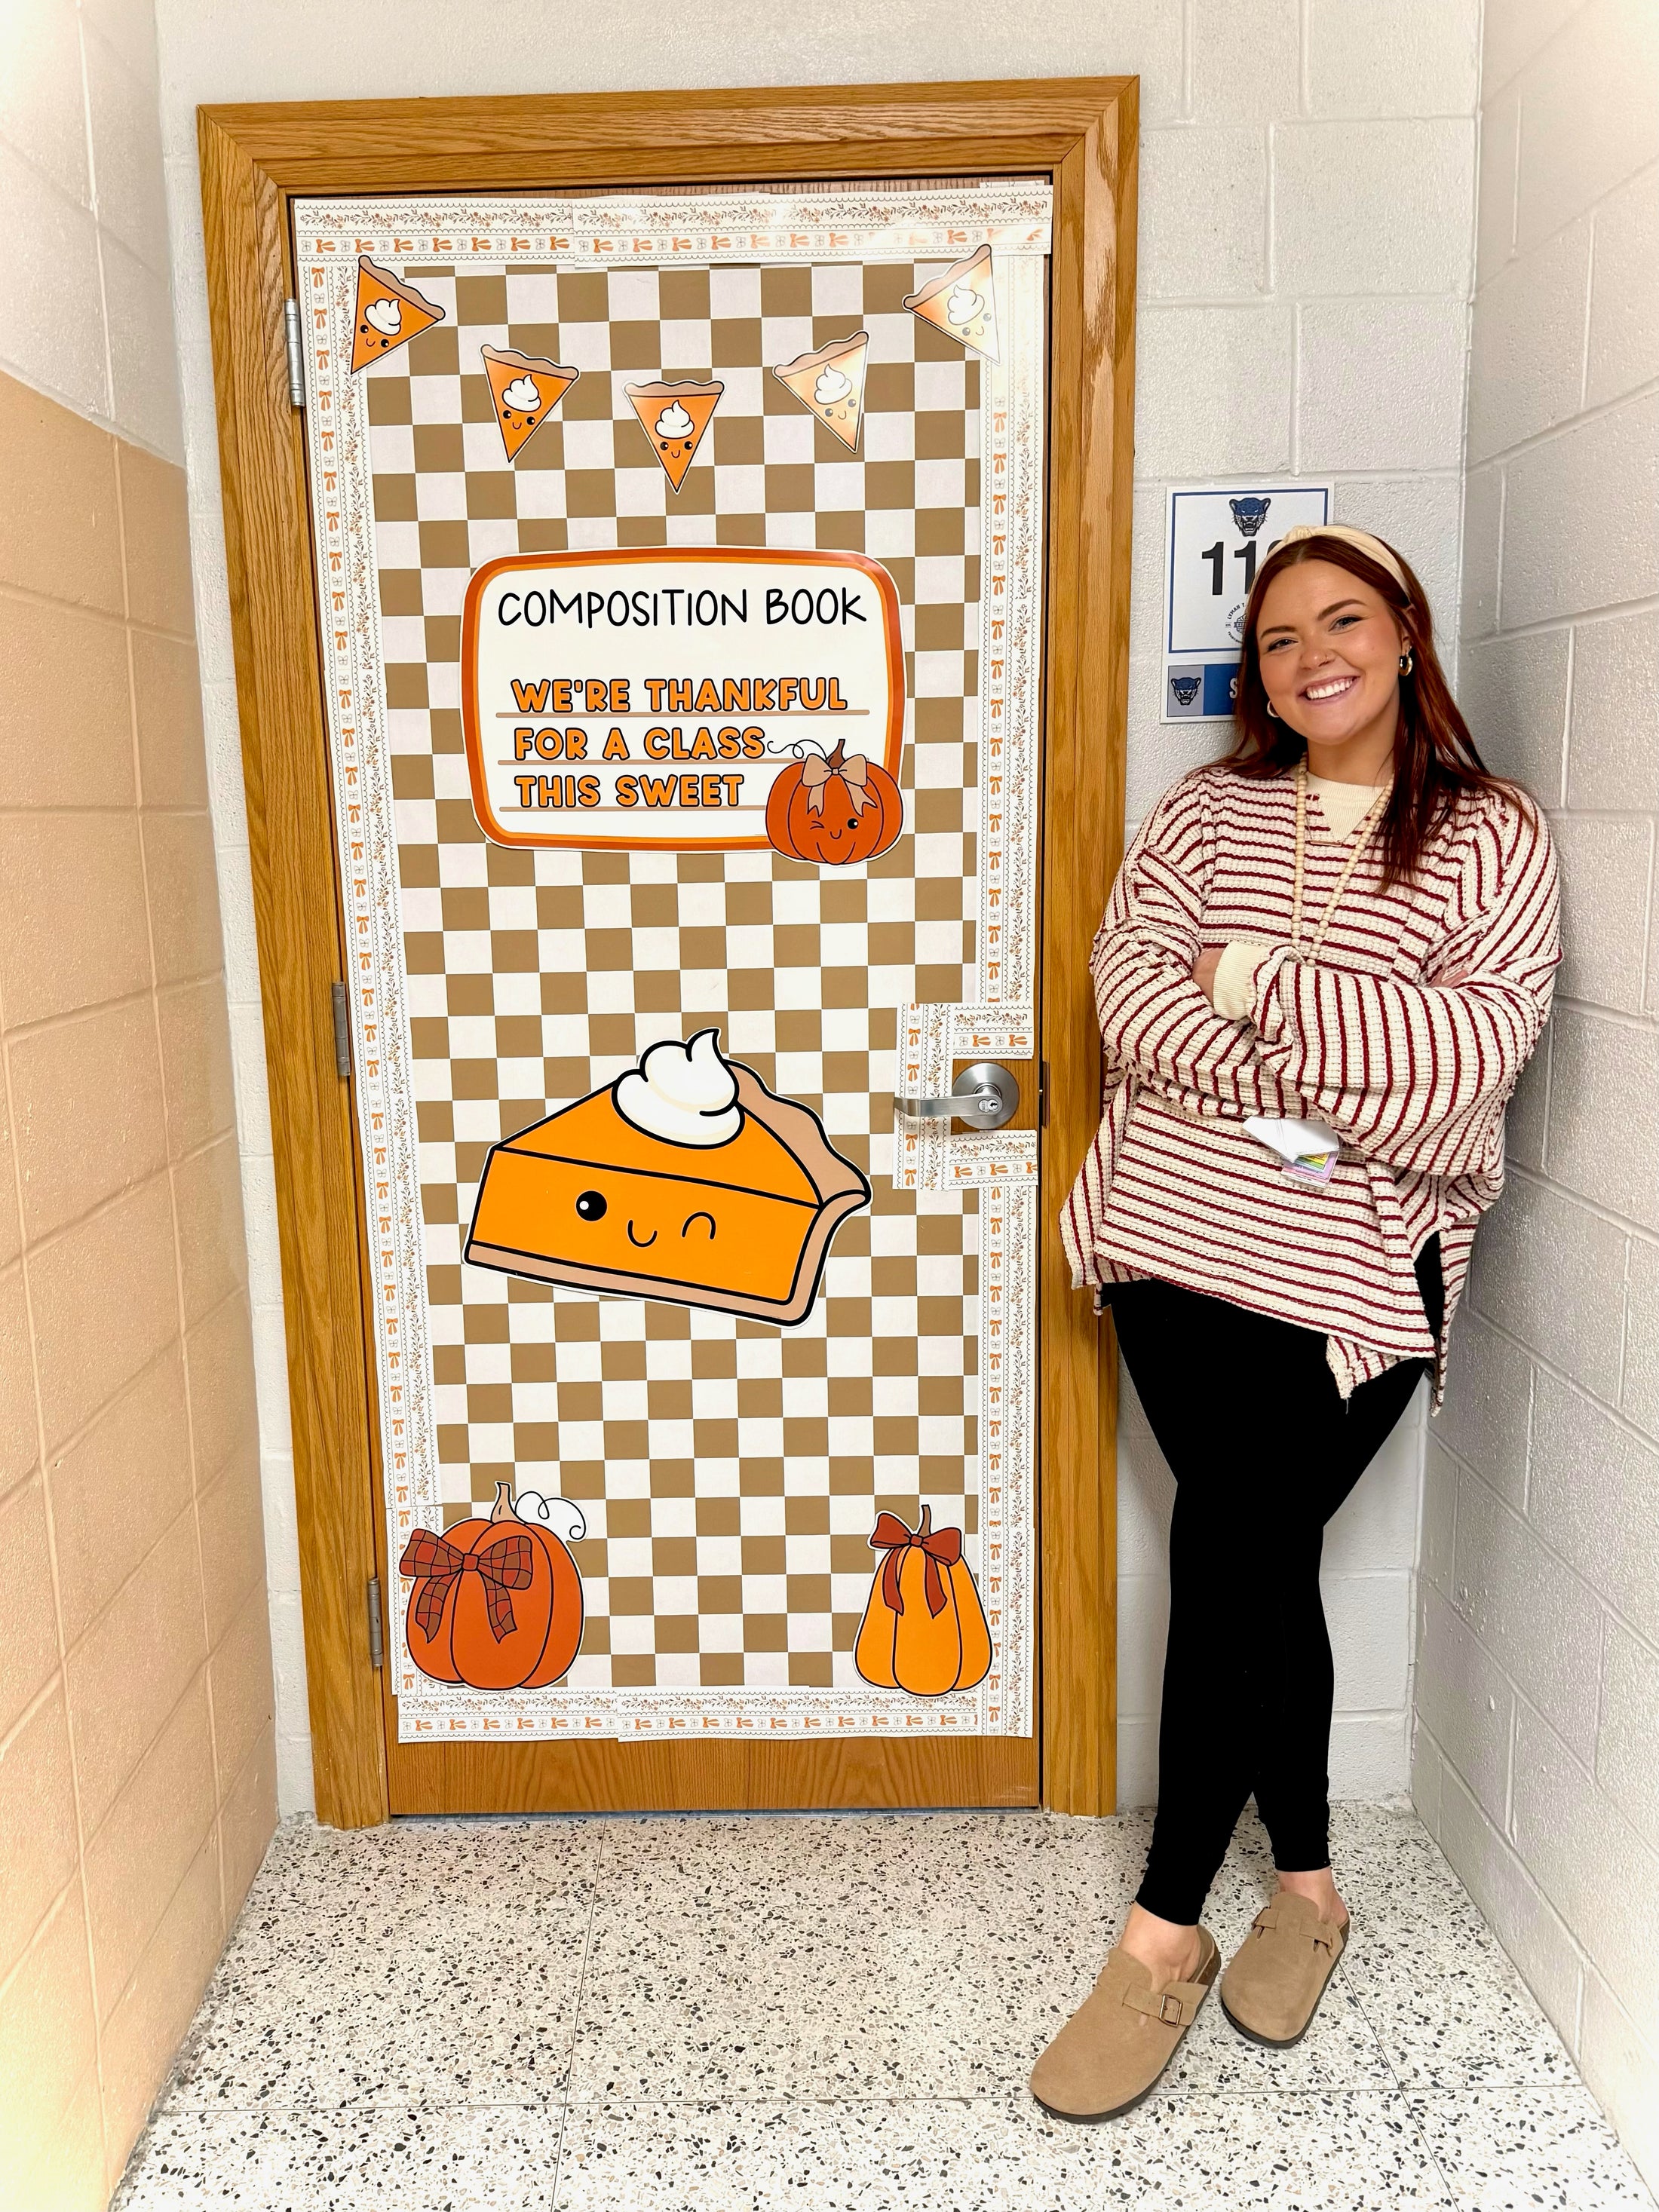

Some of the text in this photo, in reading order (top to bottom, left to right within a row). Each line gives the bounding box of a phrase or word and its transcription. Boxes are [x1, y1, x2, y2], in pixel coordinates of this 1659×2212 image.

[1202, 540, 1283, 595] 11
[498, 587, 867, 628] COMPOSITION BOOK
[511, 677, 848, 713] WE'RE THANKFUL
[514, 726, 765, 761] FOR A CLASS
[514, 774, 745, 808] THIS SWEET
